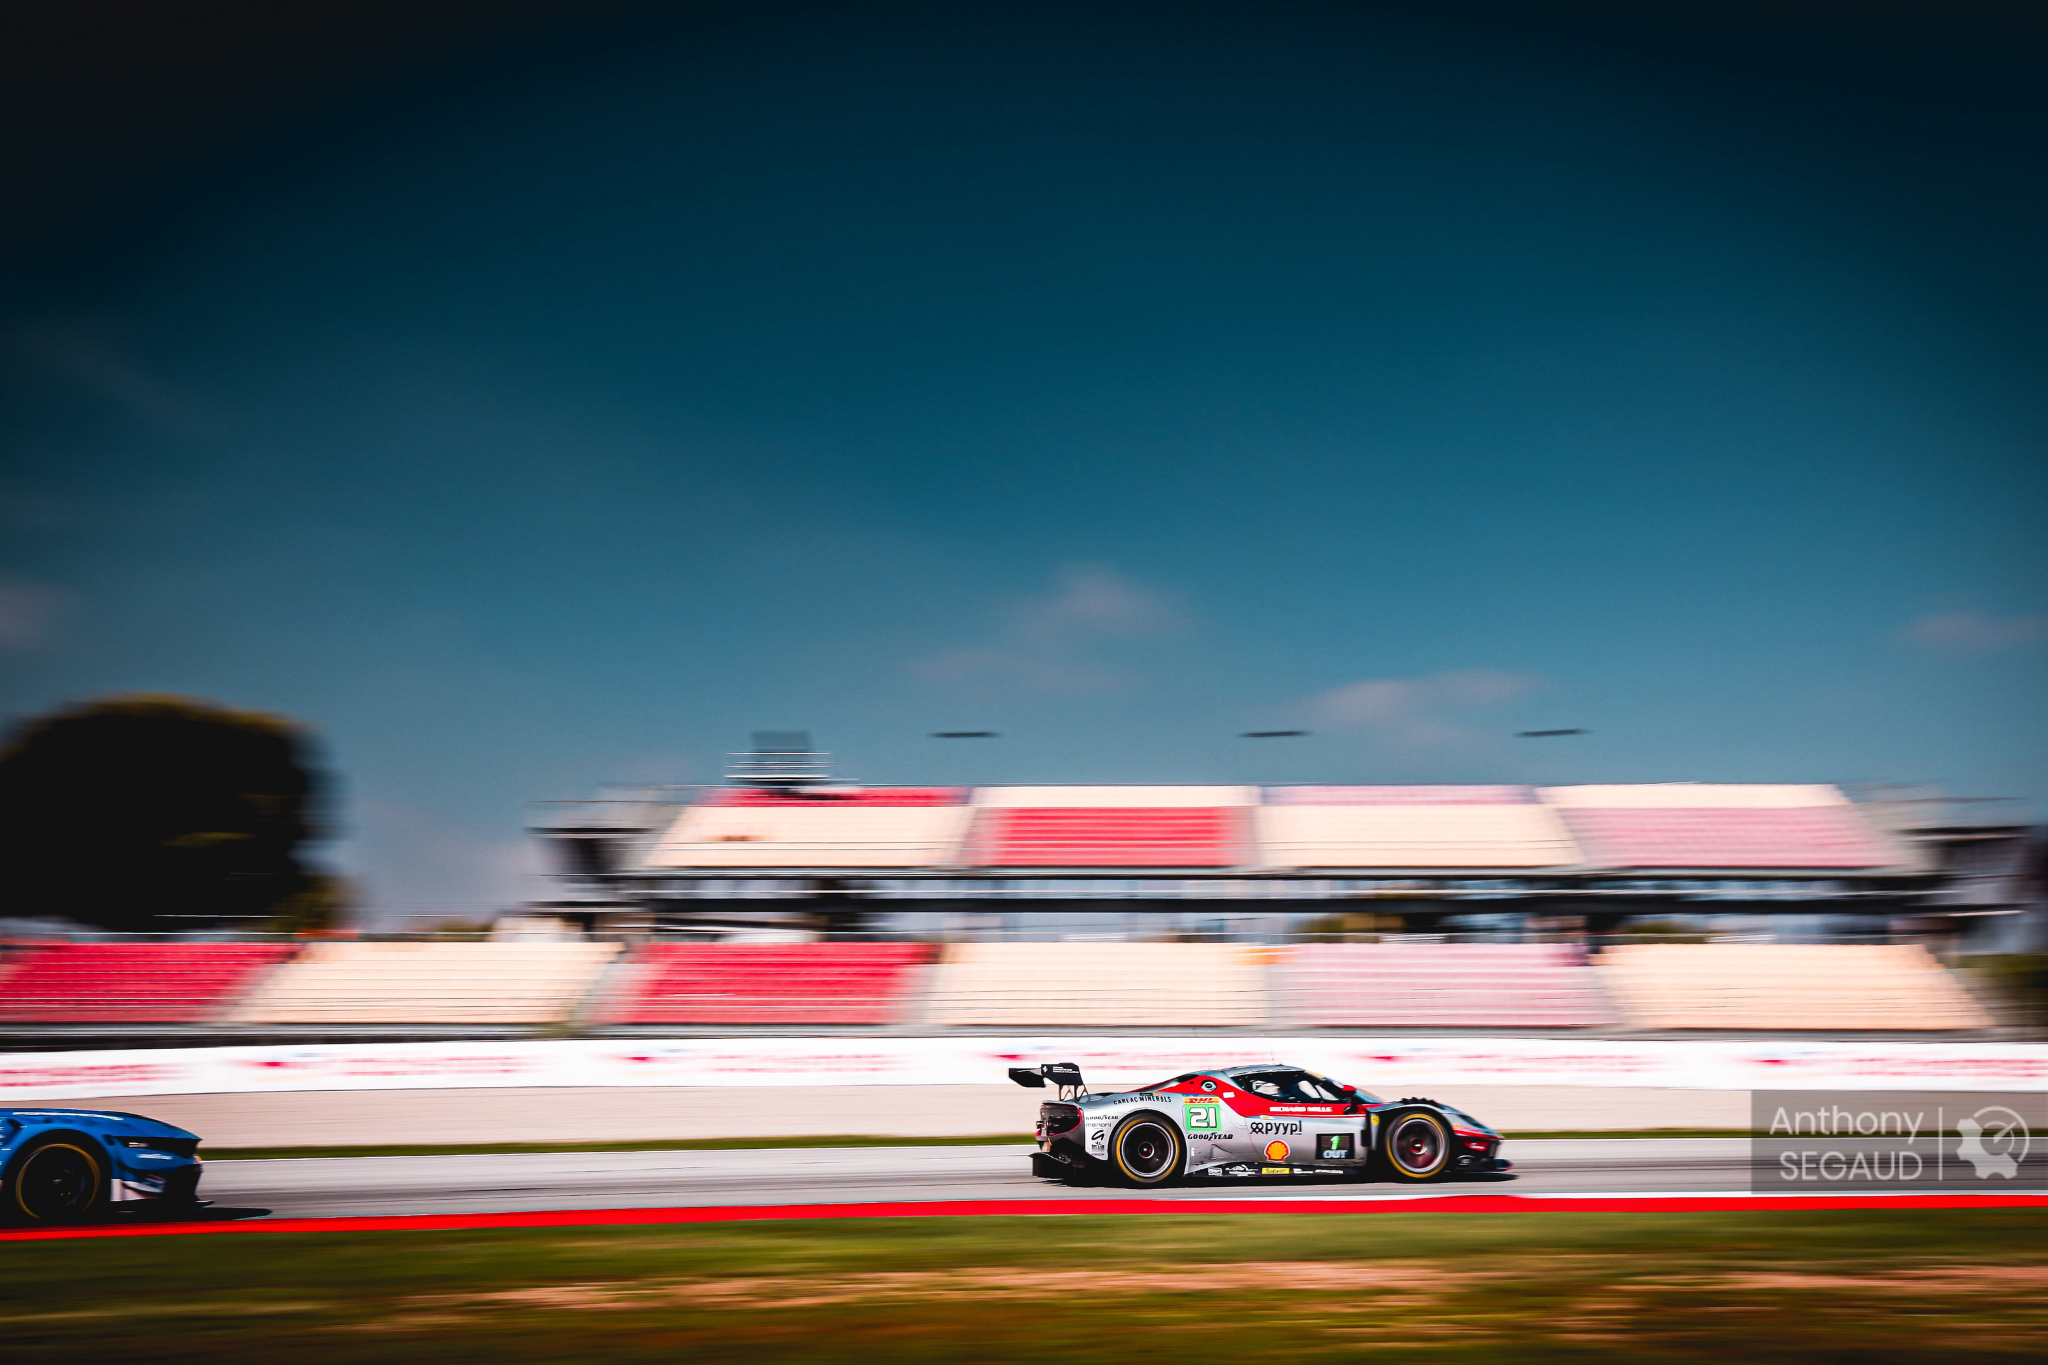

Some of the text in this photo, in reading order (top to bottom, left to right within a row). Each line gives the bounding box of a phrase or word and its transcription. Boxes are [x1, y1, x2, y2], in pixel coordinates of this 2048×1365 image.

[1189, 1107, 1217, 1128] 21
[1265, 1120, 1302, 1135] pyypl
[1187, 1132, 1234, 1141] GOODYEAR
[1330, 1135, 1341, 1150] 1
[1322, 1149, 1348, 1159] OUT
